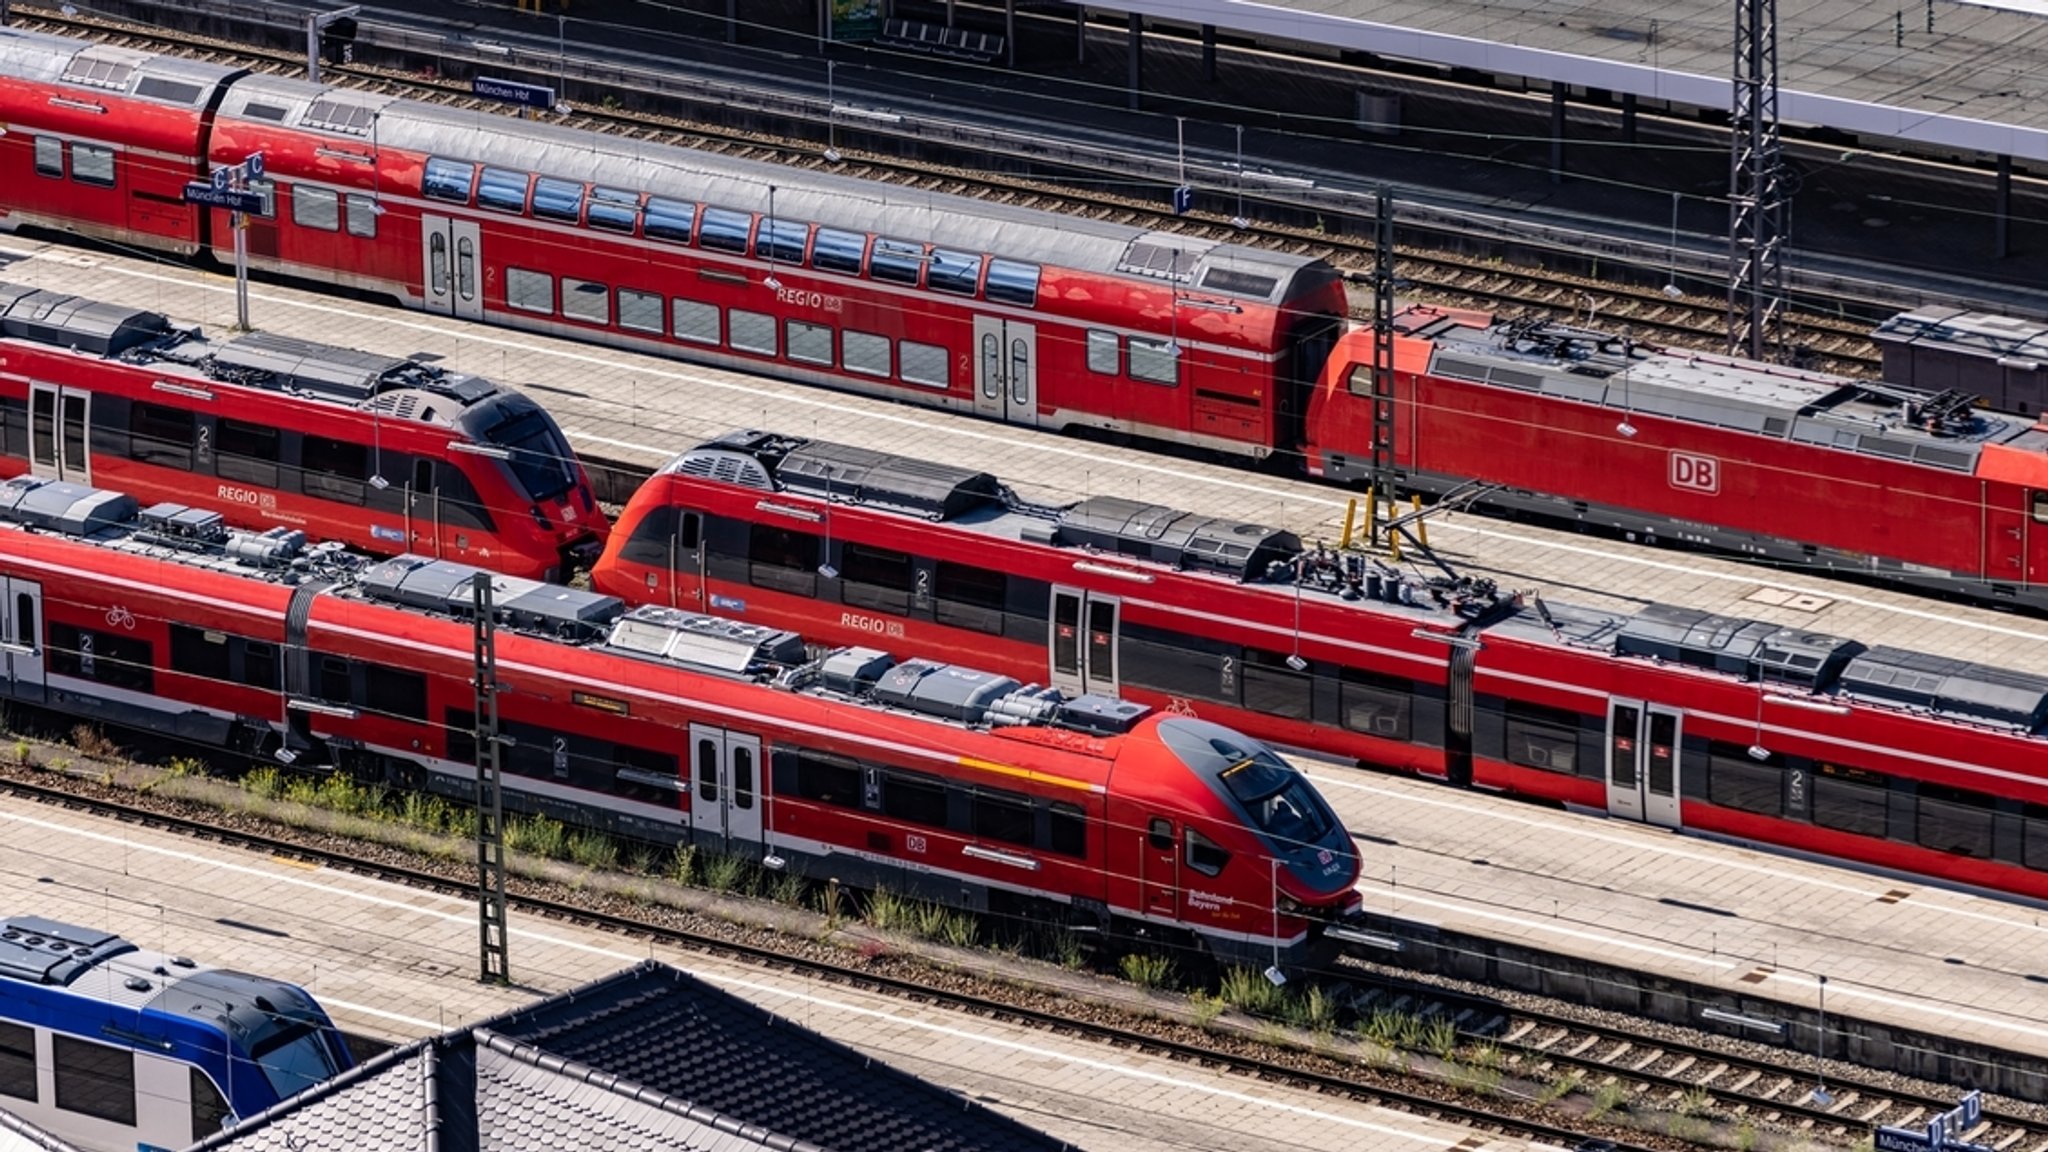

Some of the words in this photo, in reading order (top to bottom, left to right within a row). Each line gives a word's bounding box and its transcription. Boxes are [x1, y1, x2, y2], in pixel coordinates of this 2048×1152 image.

[476, 82, 513, 98] München
[515, 90, 530, 101] Hbf
[252, 155, 263, 174] C
[214, 170, 225, 190] C
[227, 194, 242, 207] Hbf
[1182, 186, 1192, 207] F
[485, 266, 495, 281] 2
[777, 287, 822, 308] REGIO
[959, 355, 969, 370] 2
[200, 425, 209, 442] 2
[1674, 455, 1715, 489] DB
[217, 484, 258, 504] REGIO
[918, 570, 928, 587] 2
[841, 612, 885, 633] REGIO
[83, 634, 92, 652] 2
[1223, 656, 1233, 673] 2
[556, 738, 566, 753] 2
[869, 768, 875, 785] 1
[1792, 770, 1803, 787] 2
[908, 835, 926, 852] DB
[1969, 1094, 1979, 1121] D
[1931, 1120, 1942, 1146] D
